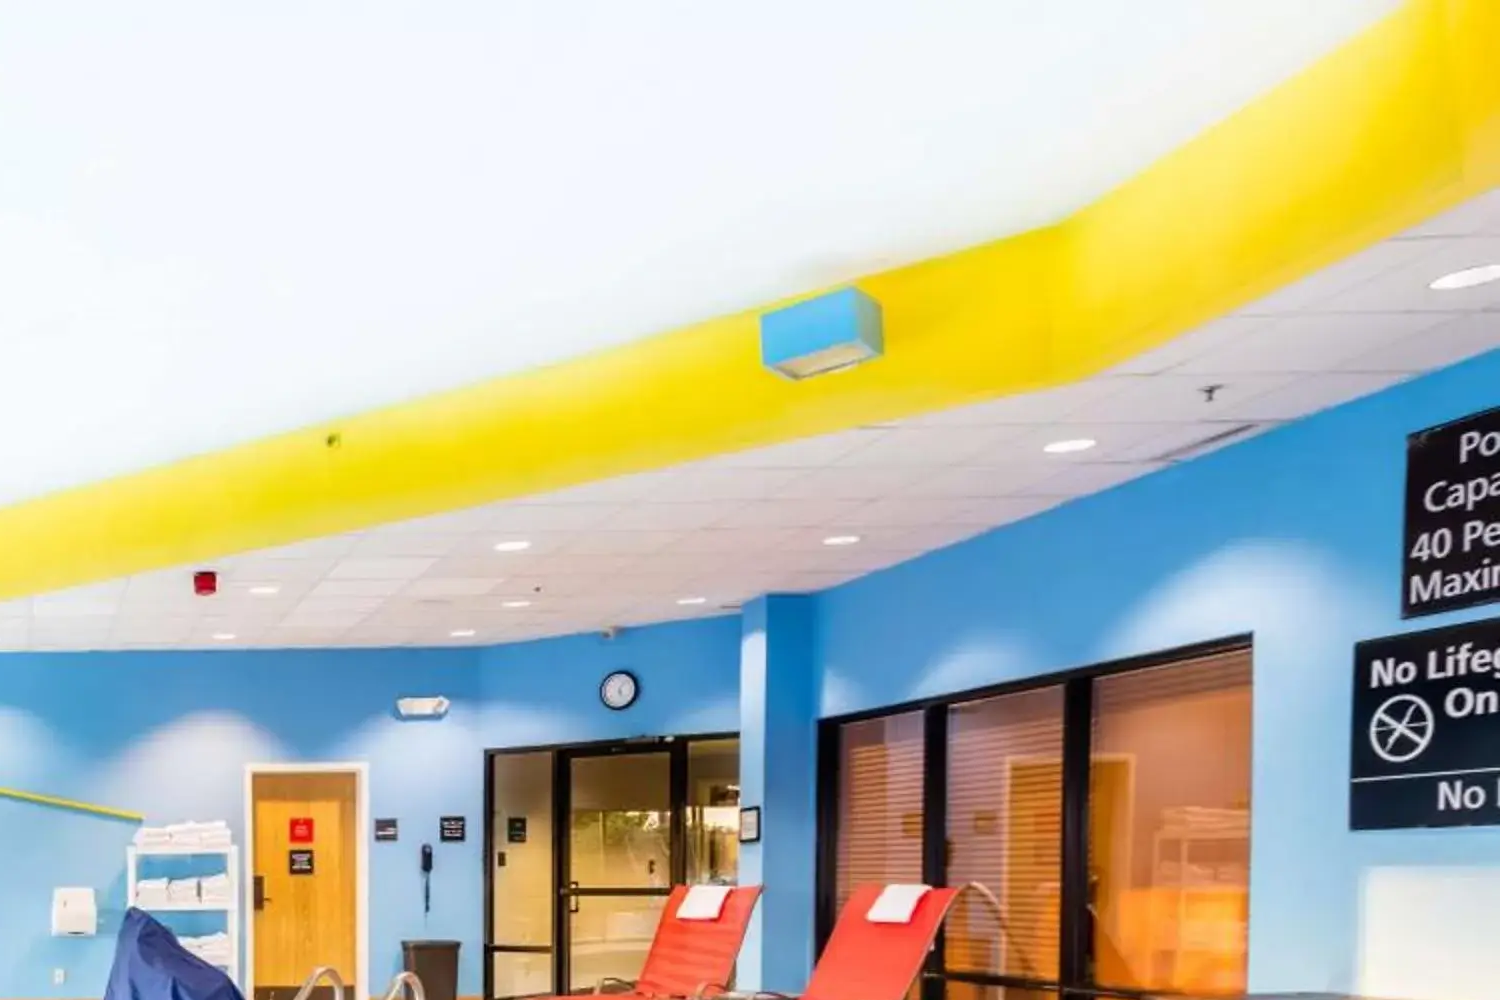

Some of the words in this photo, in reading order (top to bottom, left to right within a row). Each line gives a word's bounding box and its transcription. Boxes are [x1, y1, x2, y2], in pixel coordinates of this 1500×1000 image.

[1410, 527, 1452, 562] 40
[1463, 519, 1500, 552] Pe
[1370, 657, 1417, 688] No
[1444, 687, 1498, 718] On
[1437, 780, 1486, 811] No
